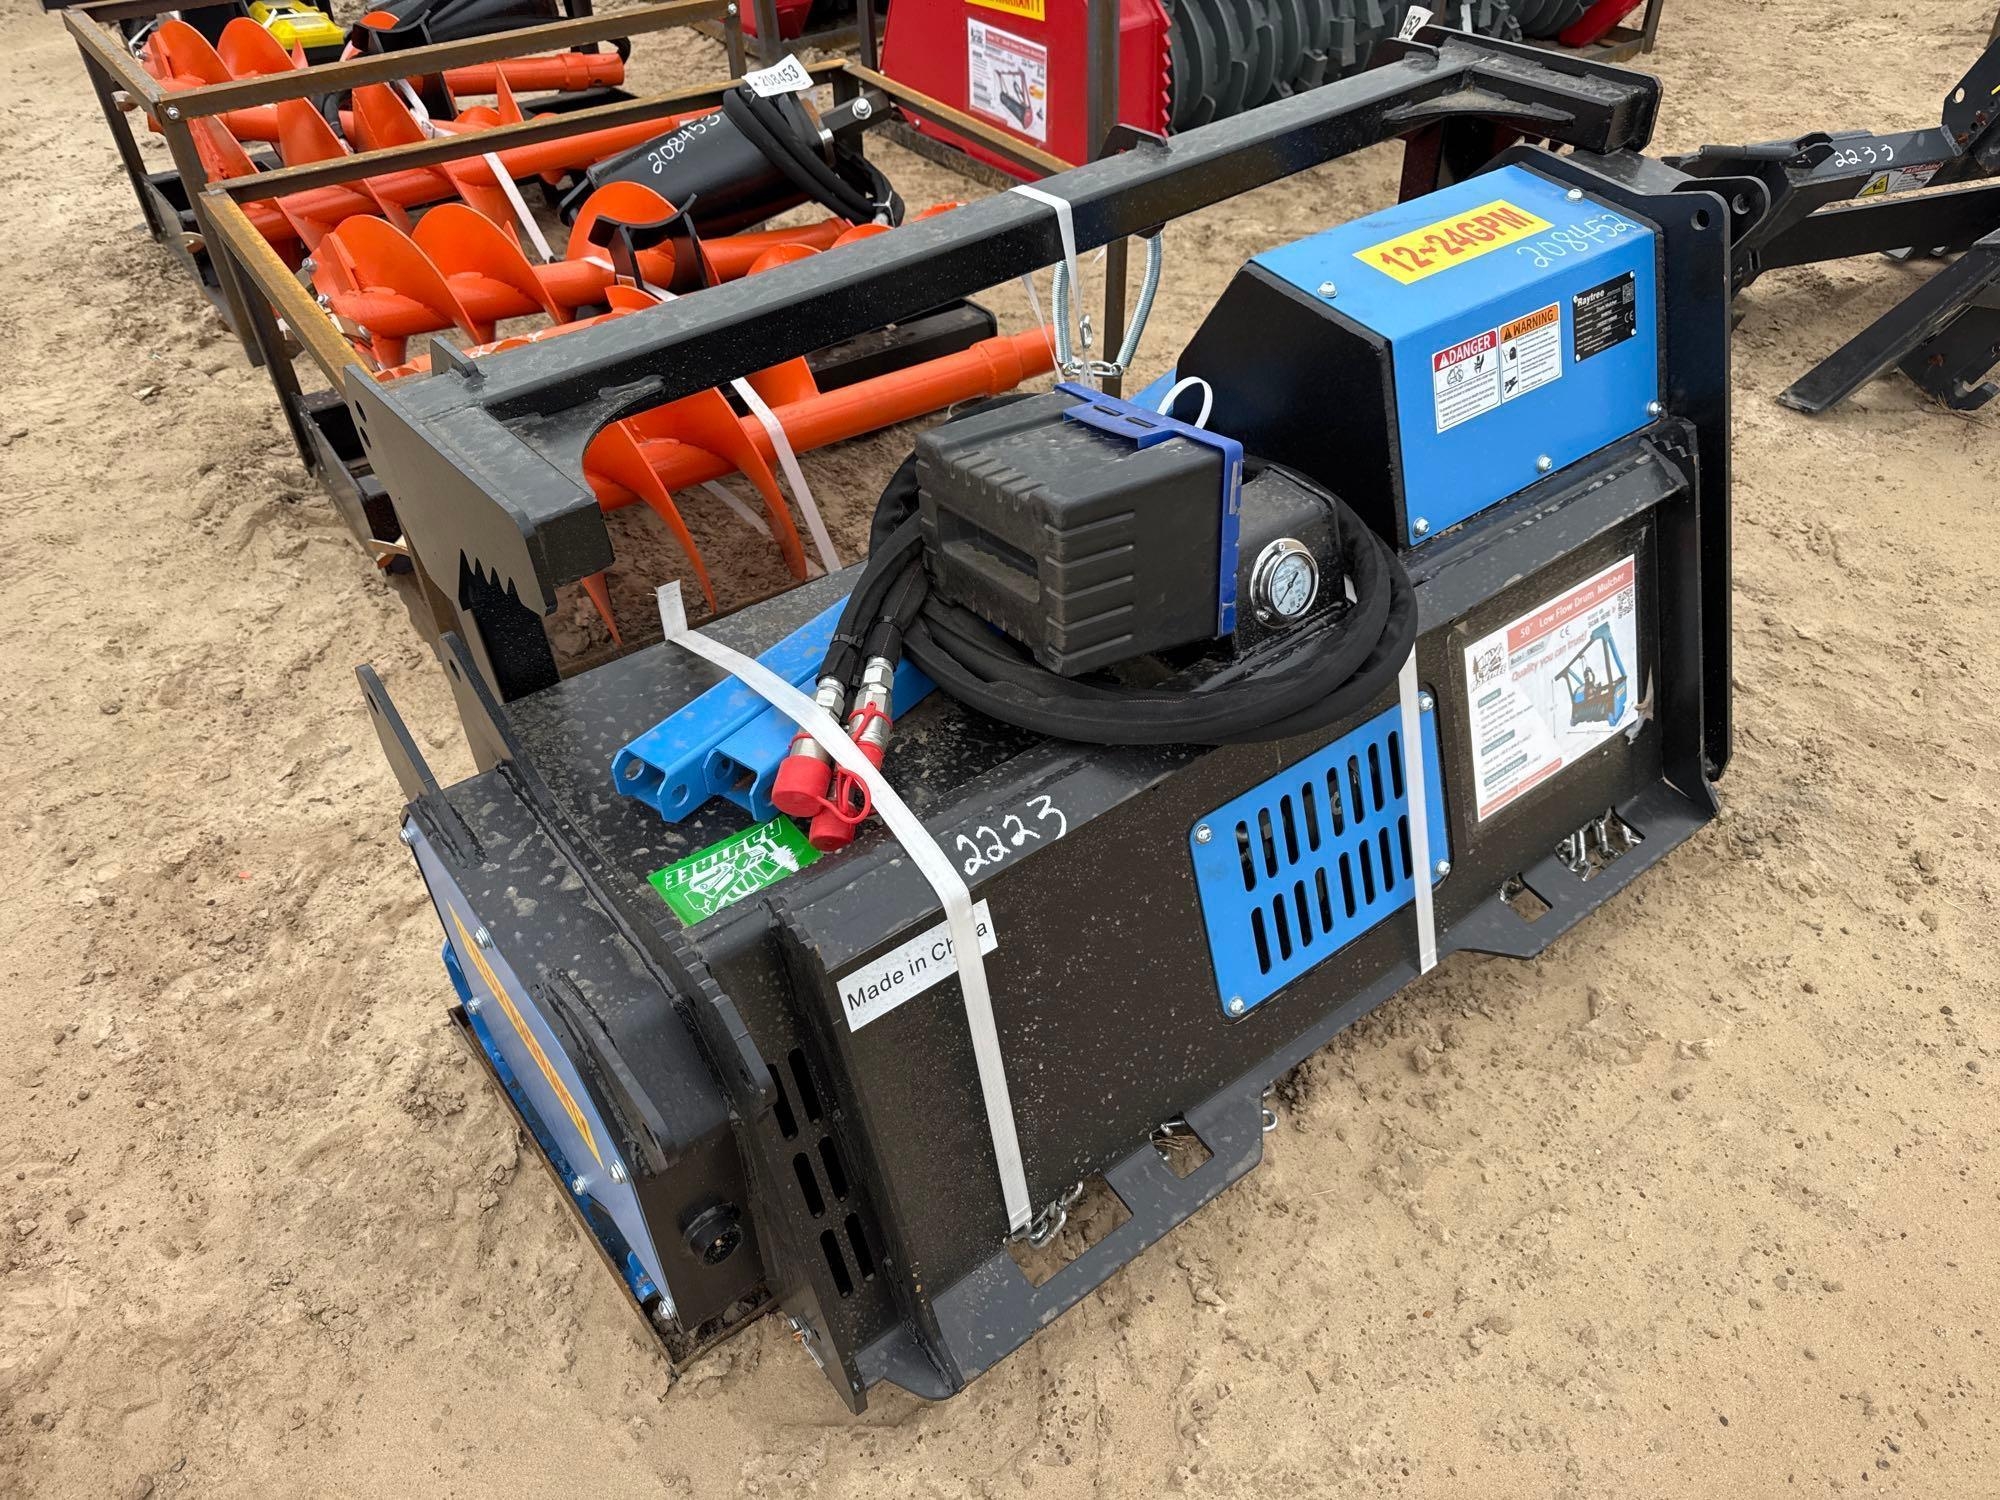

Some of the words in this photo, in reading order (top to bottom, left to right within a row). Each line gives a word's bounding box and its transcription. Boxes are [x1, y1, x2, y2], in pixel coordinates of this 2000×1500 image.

[761, 64, 800, 87] 208453
[1834, 143, 1894, 168] 2233
[1516, 214, 1636, 268] 208452
[1512, 309, 1554, 337] WARNING
[1449, 334, 1492, 364] DANGER
[1539, 613, 1555, 629] Low
[1574, 591, 1595, 608] Drum
[1597, 572, 1625, 595] Mulcher
[1511, 661, 1538, 682] Quality
[1539, 652, 1554, 667] you
[1554, 644, 1568, 658] can
[956, 794, 1067, 877] 2223
[846, 971, 905, 1011] Made
[908, 958, 928, 979] in
[932, 920, 989, 963] Cha
